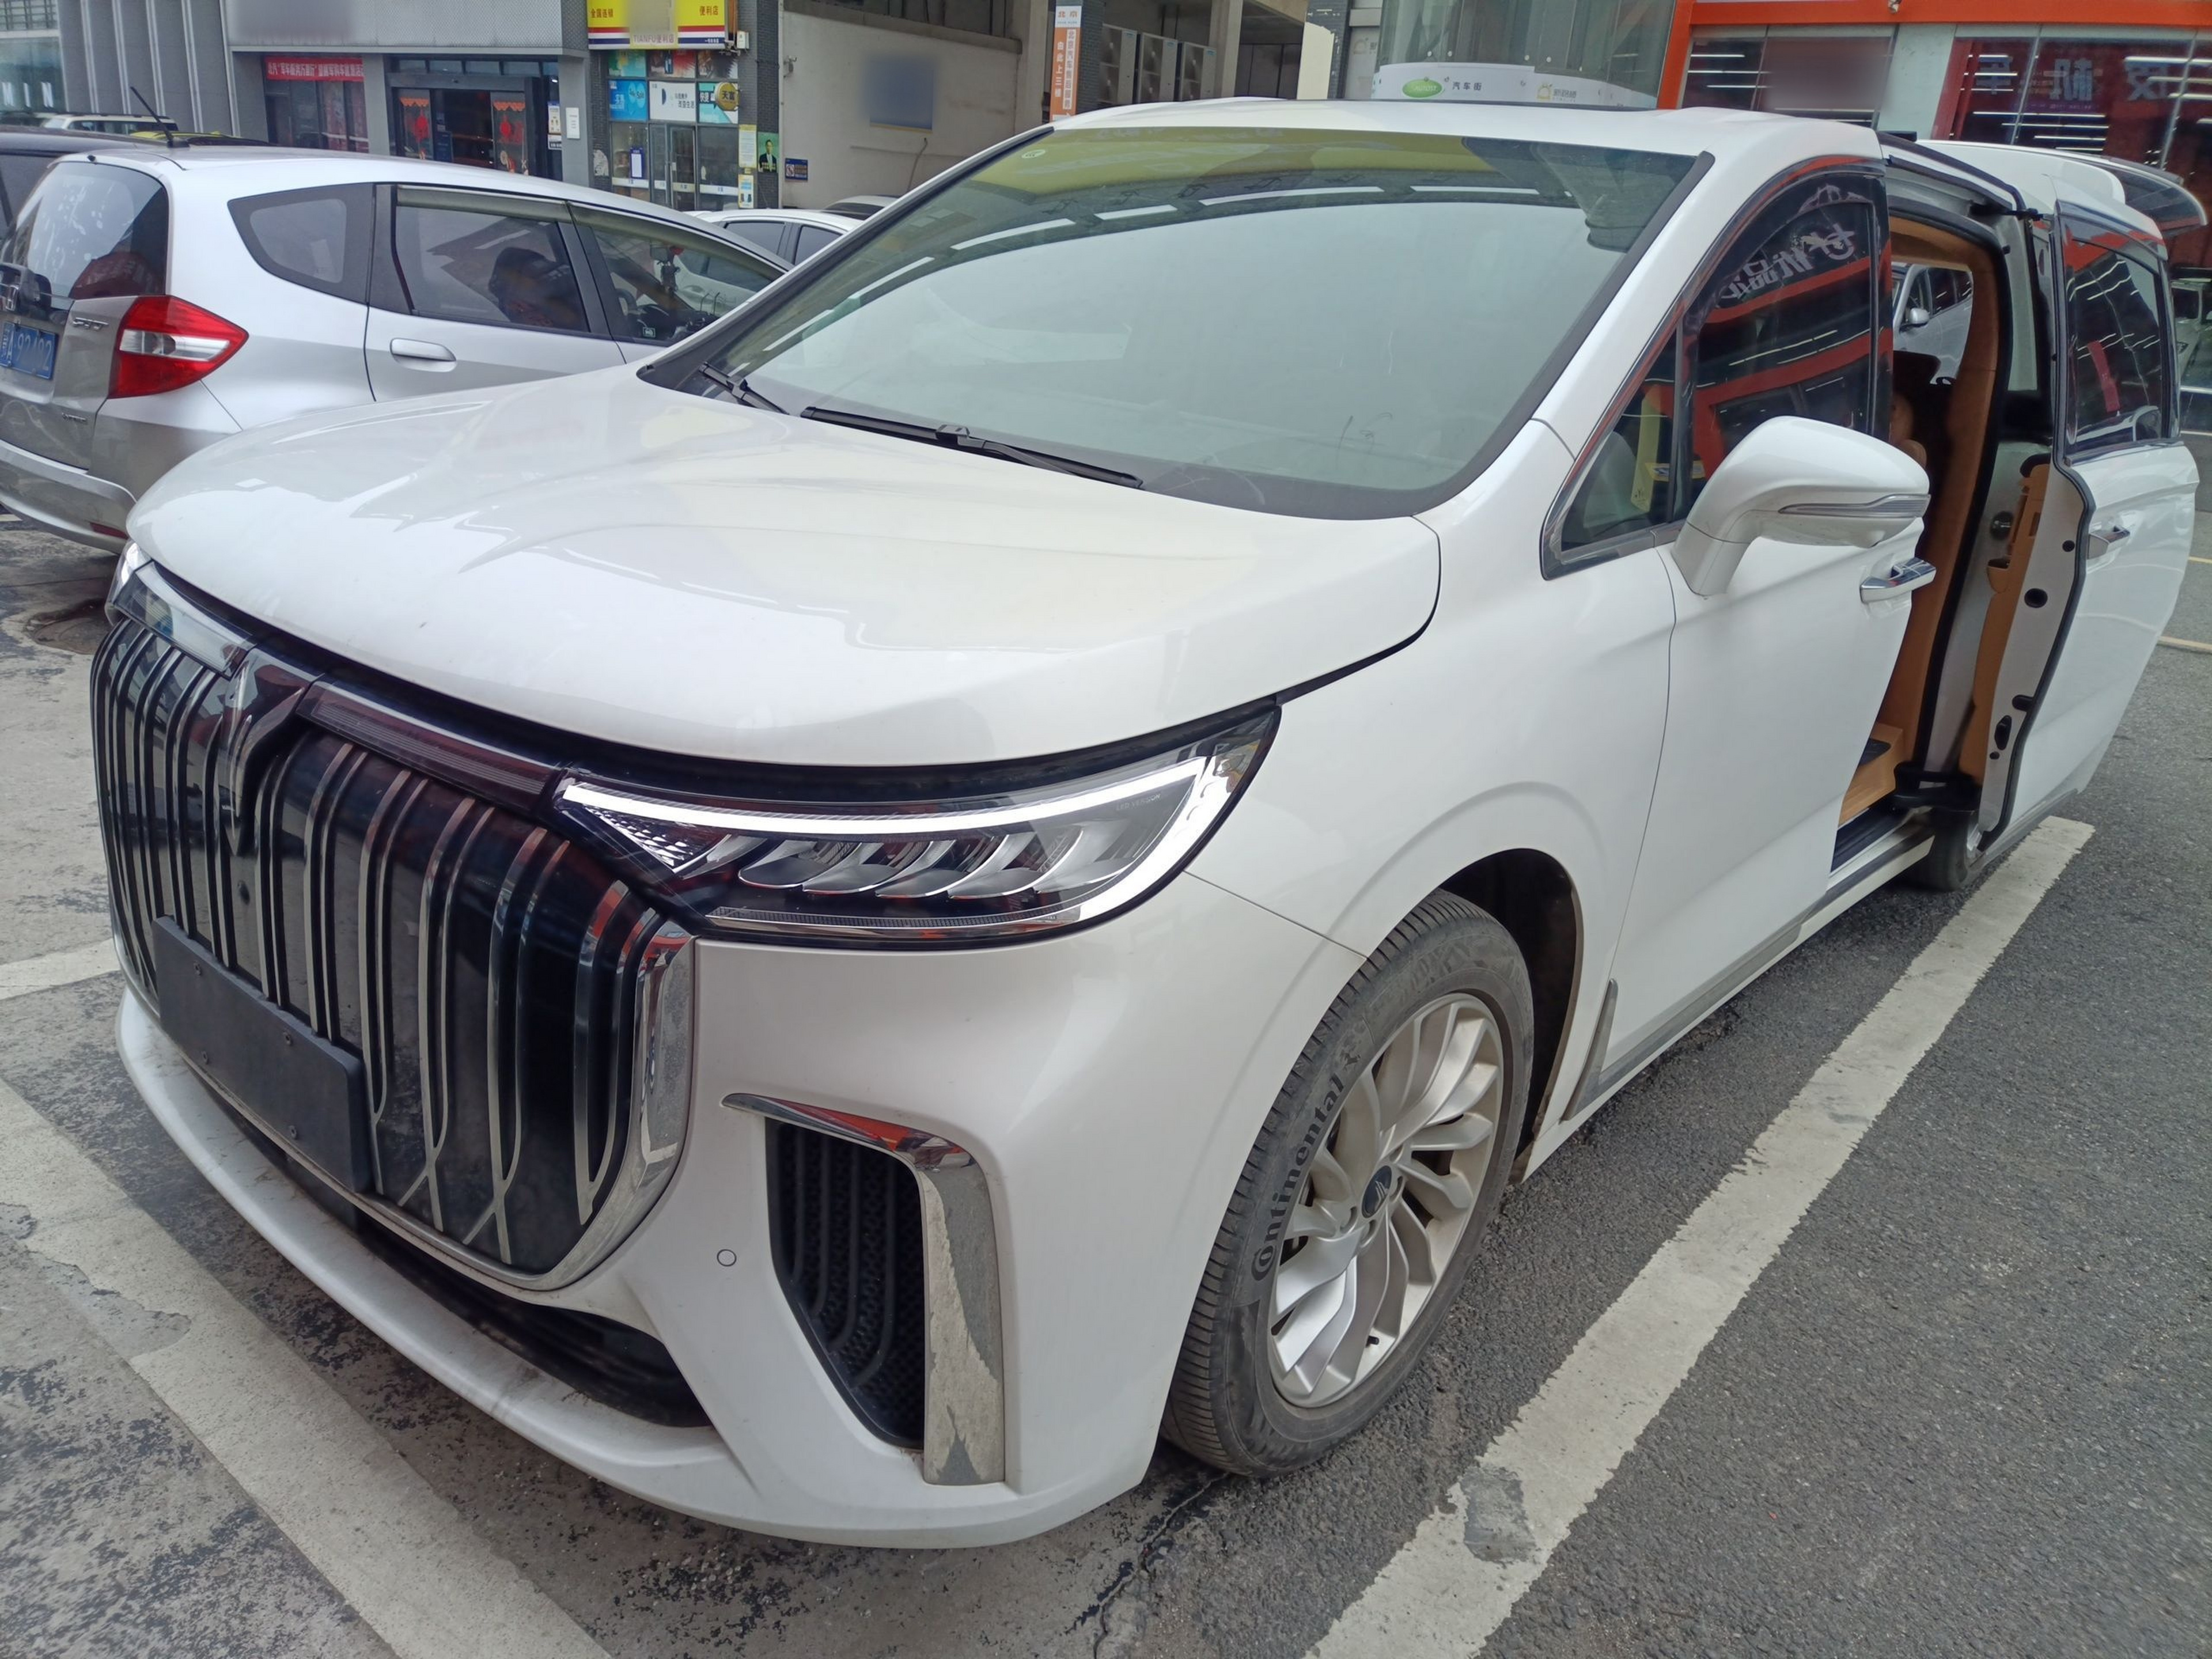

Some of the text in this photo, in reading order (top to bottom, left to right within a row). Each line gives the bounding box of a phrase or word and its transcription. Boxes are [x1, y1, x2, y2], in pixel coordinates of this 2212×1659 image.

[699, 6, 719, 16] 便利店
[1452, 82, 1482, 91] 汽车街
[1251, 1073, 1344, 1281] Continental
